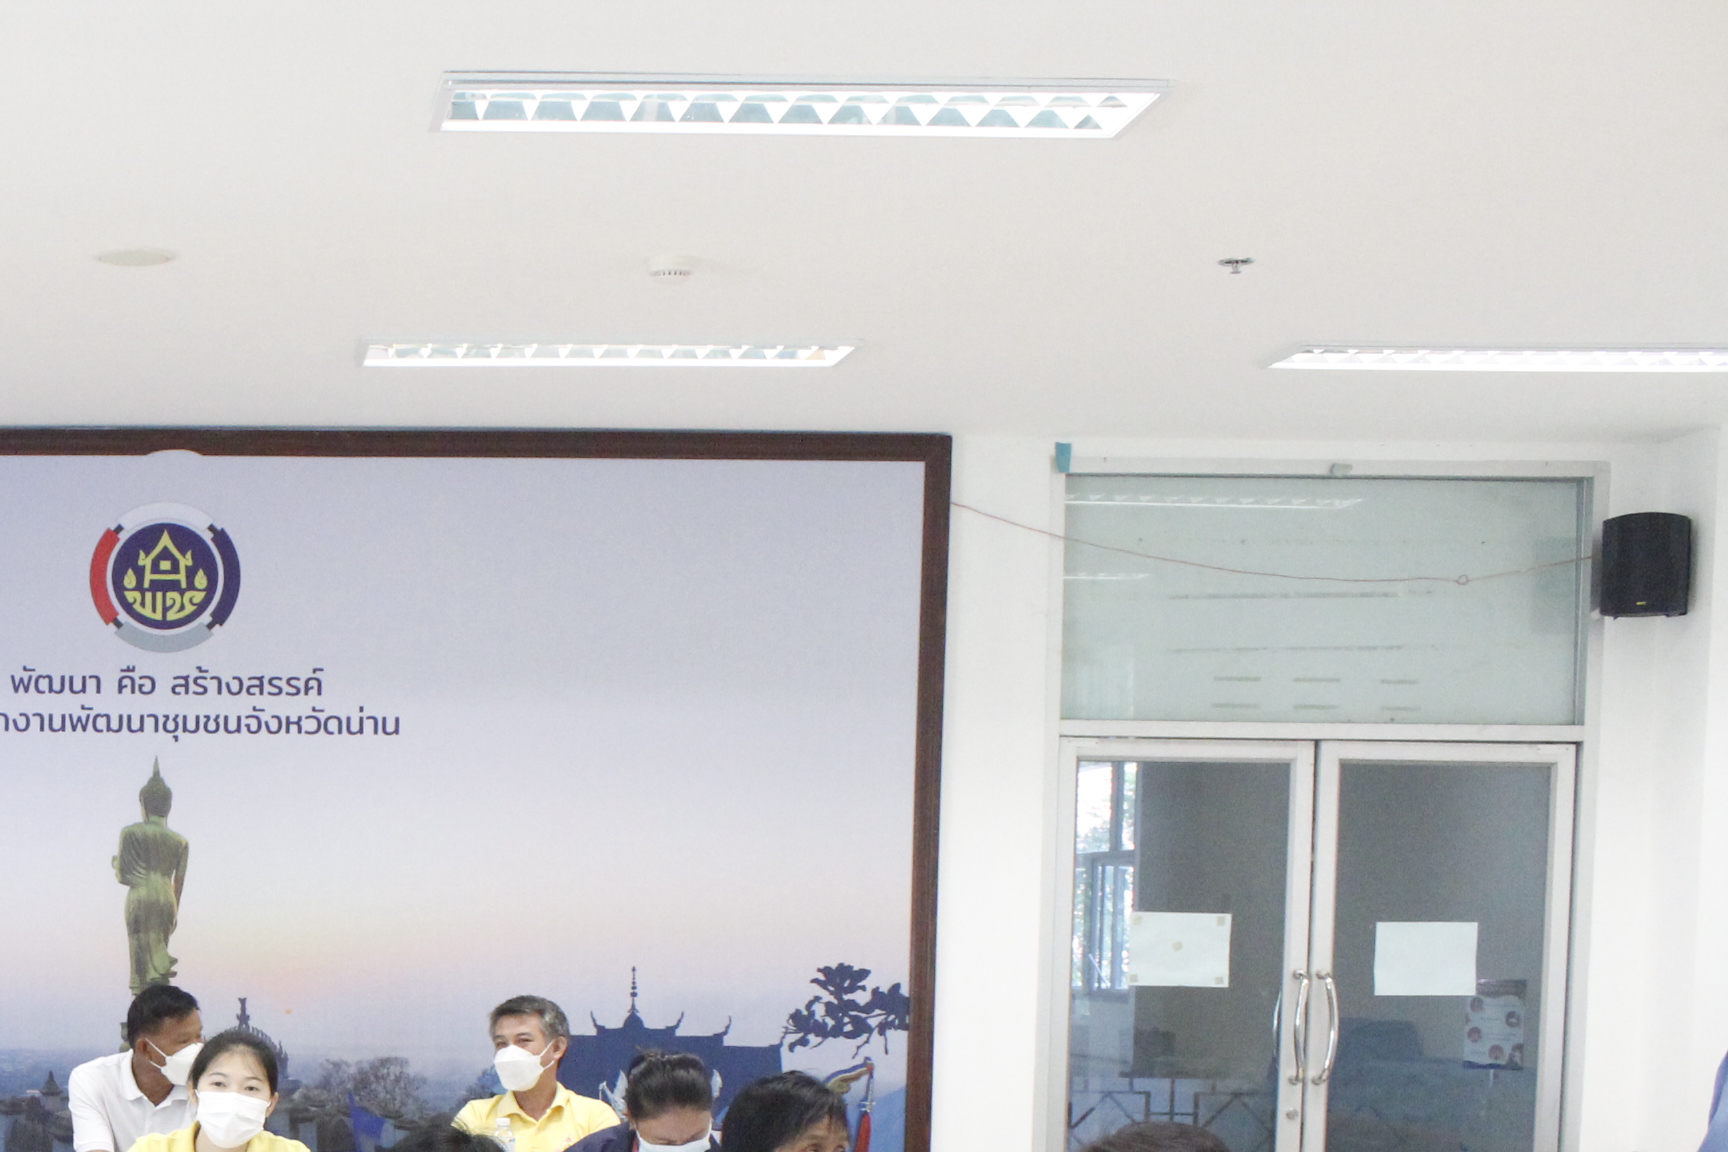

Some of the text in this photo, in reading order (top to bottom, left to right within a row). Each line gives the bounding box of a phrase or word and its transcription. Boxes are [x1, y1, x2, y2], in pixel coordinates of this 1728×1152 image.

[10, 665, 324, 697] พัฒนา คือ สร้างสรรค์
